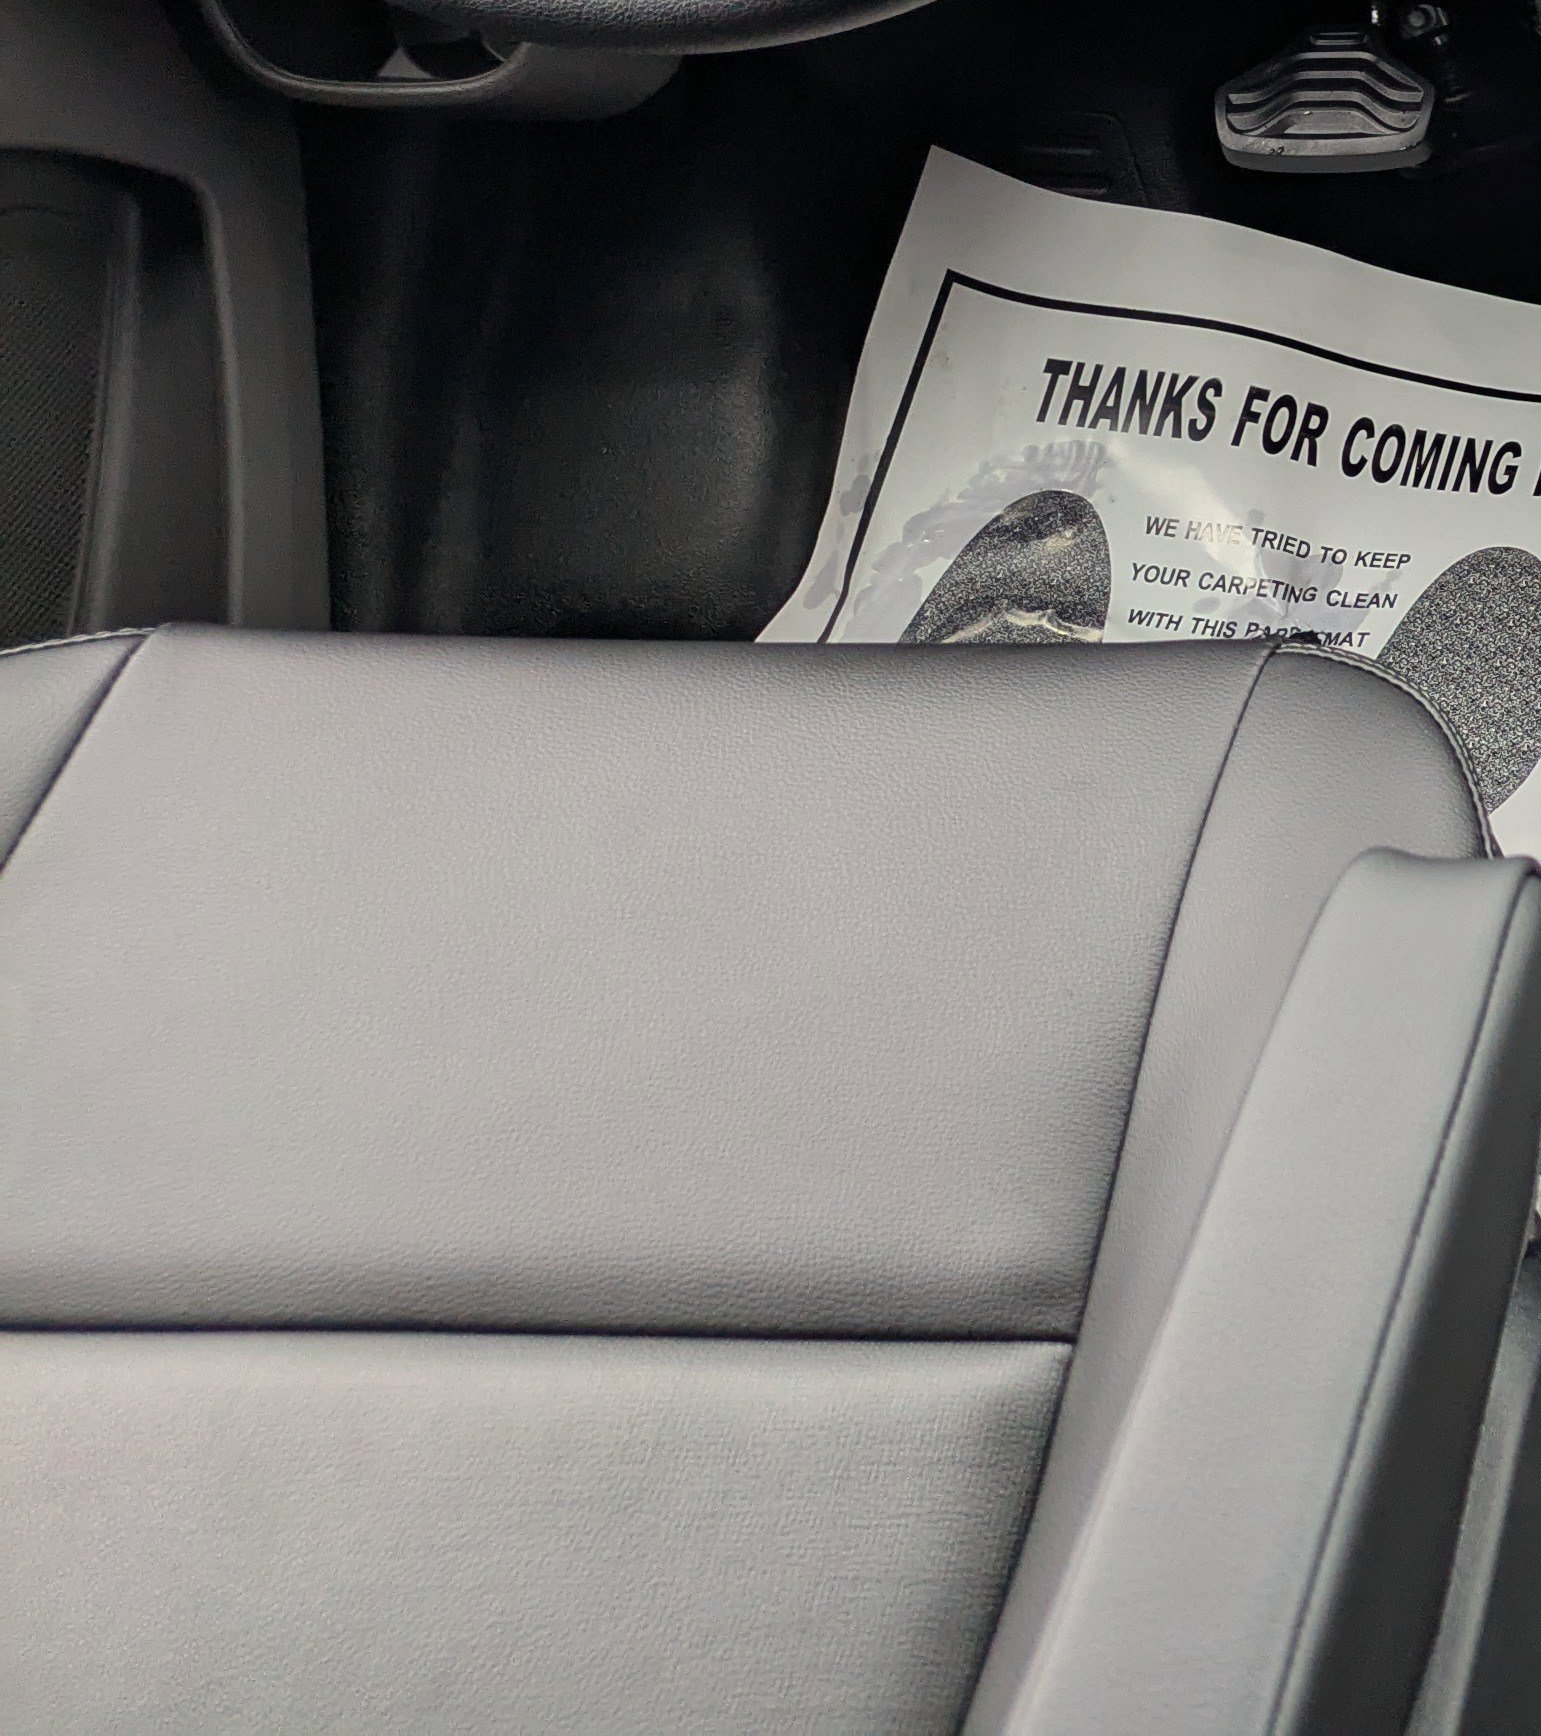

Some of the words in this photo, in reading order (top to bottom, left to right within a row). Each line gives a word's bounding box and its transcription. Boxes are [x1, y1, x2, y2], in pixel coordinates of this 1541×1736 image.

[1035, 357, 1223, 442] THANKS
[1231, 385, 1330, 467] FOR
[1341, 416, 1522, 496] COMING
[1145, 516, 1180, 538] WE
[1185, 519, 1243, 545] HAVE
[1250, 527, 1311, 559] TRIED
[1320, 546, 1347, 565] TO
[1354, 550, 1411, 570] KEEP
[1131, 562, 1191, 588] YOUR
[1198, 572, 1318, 604] CARPETING
[1326, 589, 1399, 609] CLEAN
[1127, 609, 1183, 631] WITH
[1190, 617, 1238, 638] THIS
[1322, 632, 1370, 648] MAT
